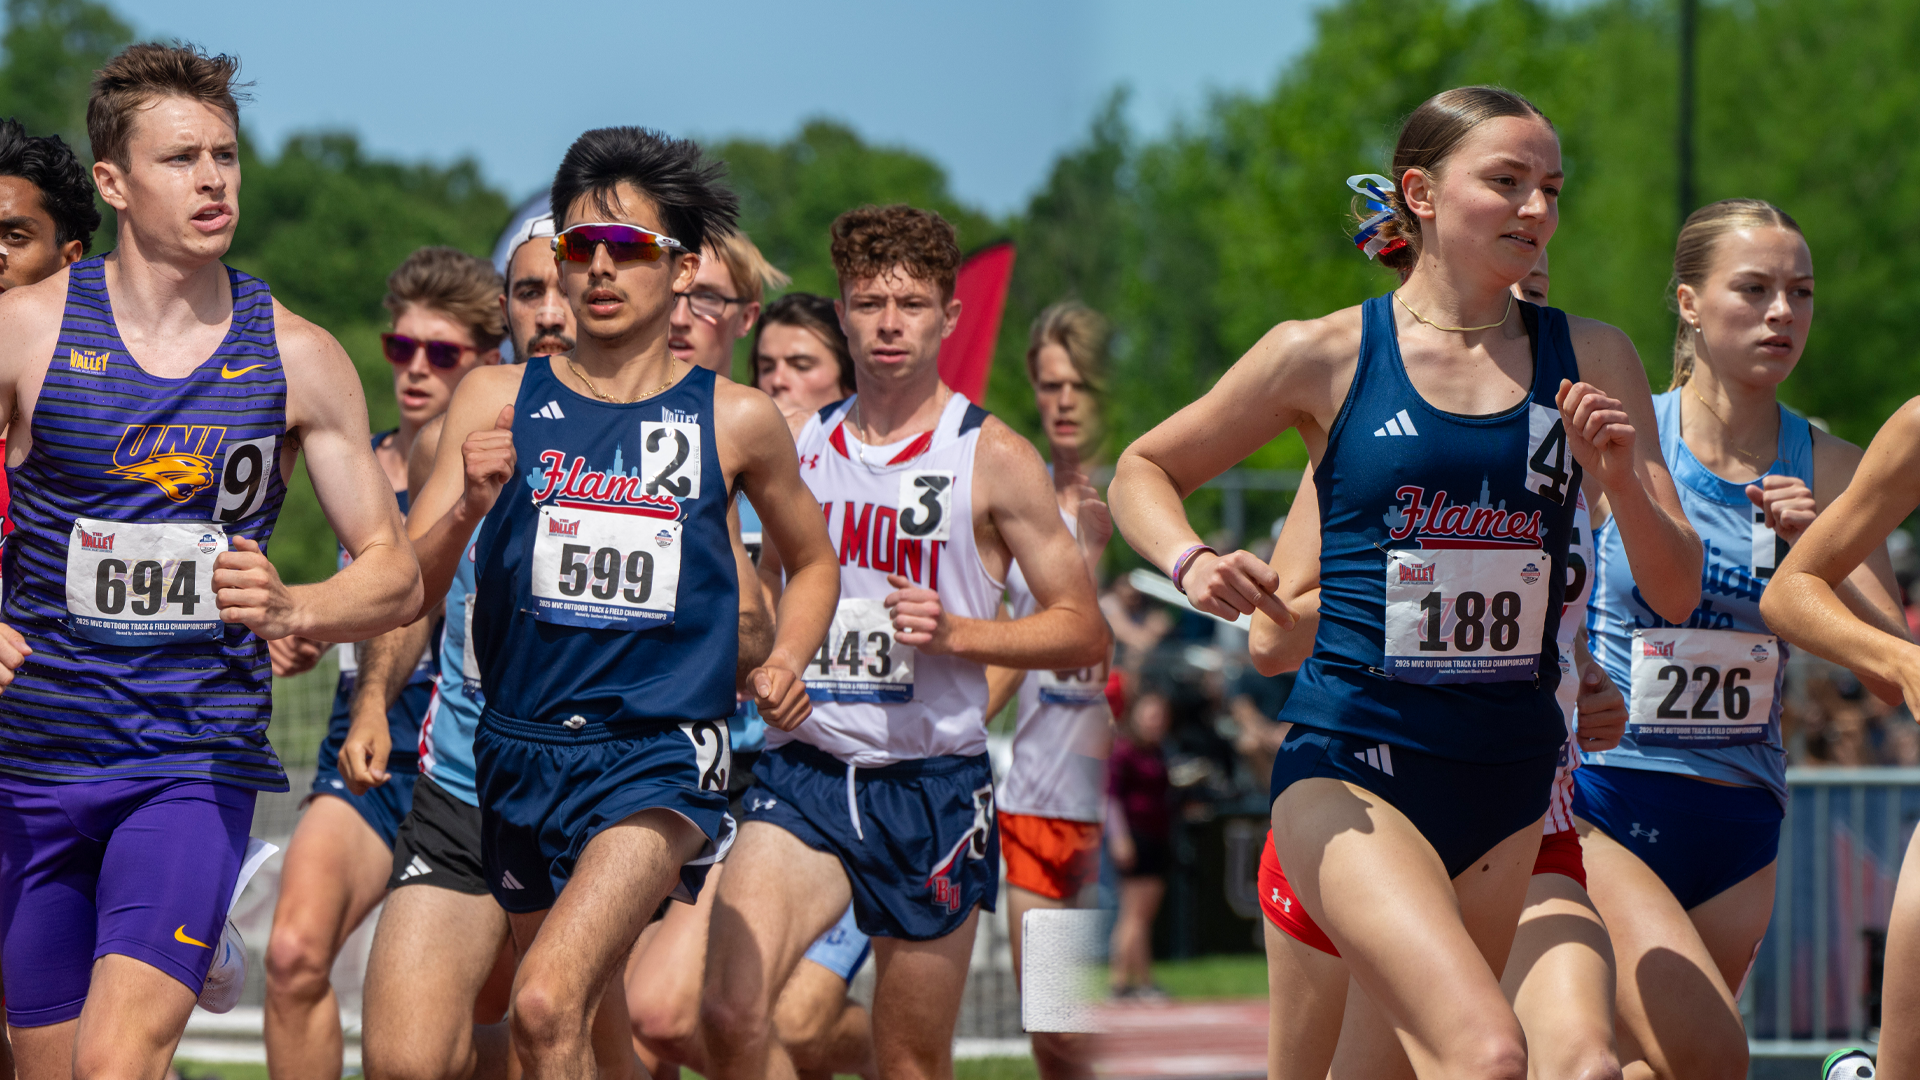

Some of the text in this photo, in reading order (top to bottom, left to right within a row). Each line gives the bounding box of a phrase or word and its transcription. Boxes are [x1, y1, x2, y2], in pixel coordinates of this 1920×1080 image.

[70, 348, 110, 371] VALLEY
[113, 424, 227, 467] UNI
[646, 427, 692, 497] 2
[1529, 418, 1569, 506] 4
[219, 443, 263, 522] 9
[532, 450, 681, 512] Flam
[899, 475, 951, 537] 3
[81, 529, 115, 551] VALLEY
[549, 516, 581, 536] VALLEY
[1389, 484, 1543, 545] Flames
[95, 558, 201, 616] 694
[558, 543, 655, 604] 599
[1399, 562, 1436, 582] VALLEY
[75, 617, 90, 626] 2025
[90, 619, 102, 628] MVC
[103, 621, 129, 630] OUTDOOR
[130, 622, 149, 630] TRACK
[170, 622, 217, 630] CHAMPIONSHIPS
[539, 599, 668, 621] 2025 MVC OUTDOOR TRACK & FIELD CHAMPIONSHIPS
[1419, 590, 1522, 652] 188
[810, 630, 891, 678] 443
[1395, 657, 1534, 668] 2025 MVC OUTDOOR TRACK & FIELD CHAMPIONSHIPS
[1643, 640, 1676, 657] VALLEY
[1656, 664, 1751, 720] 226
[691, 720, 726, 791] 2
[933, 876, 961, 913] BU
